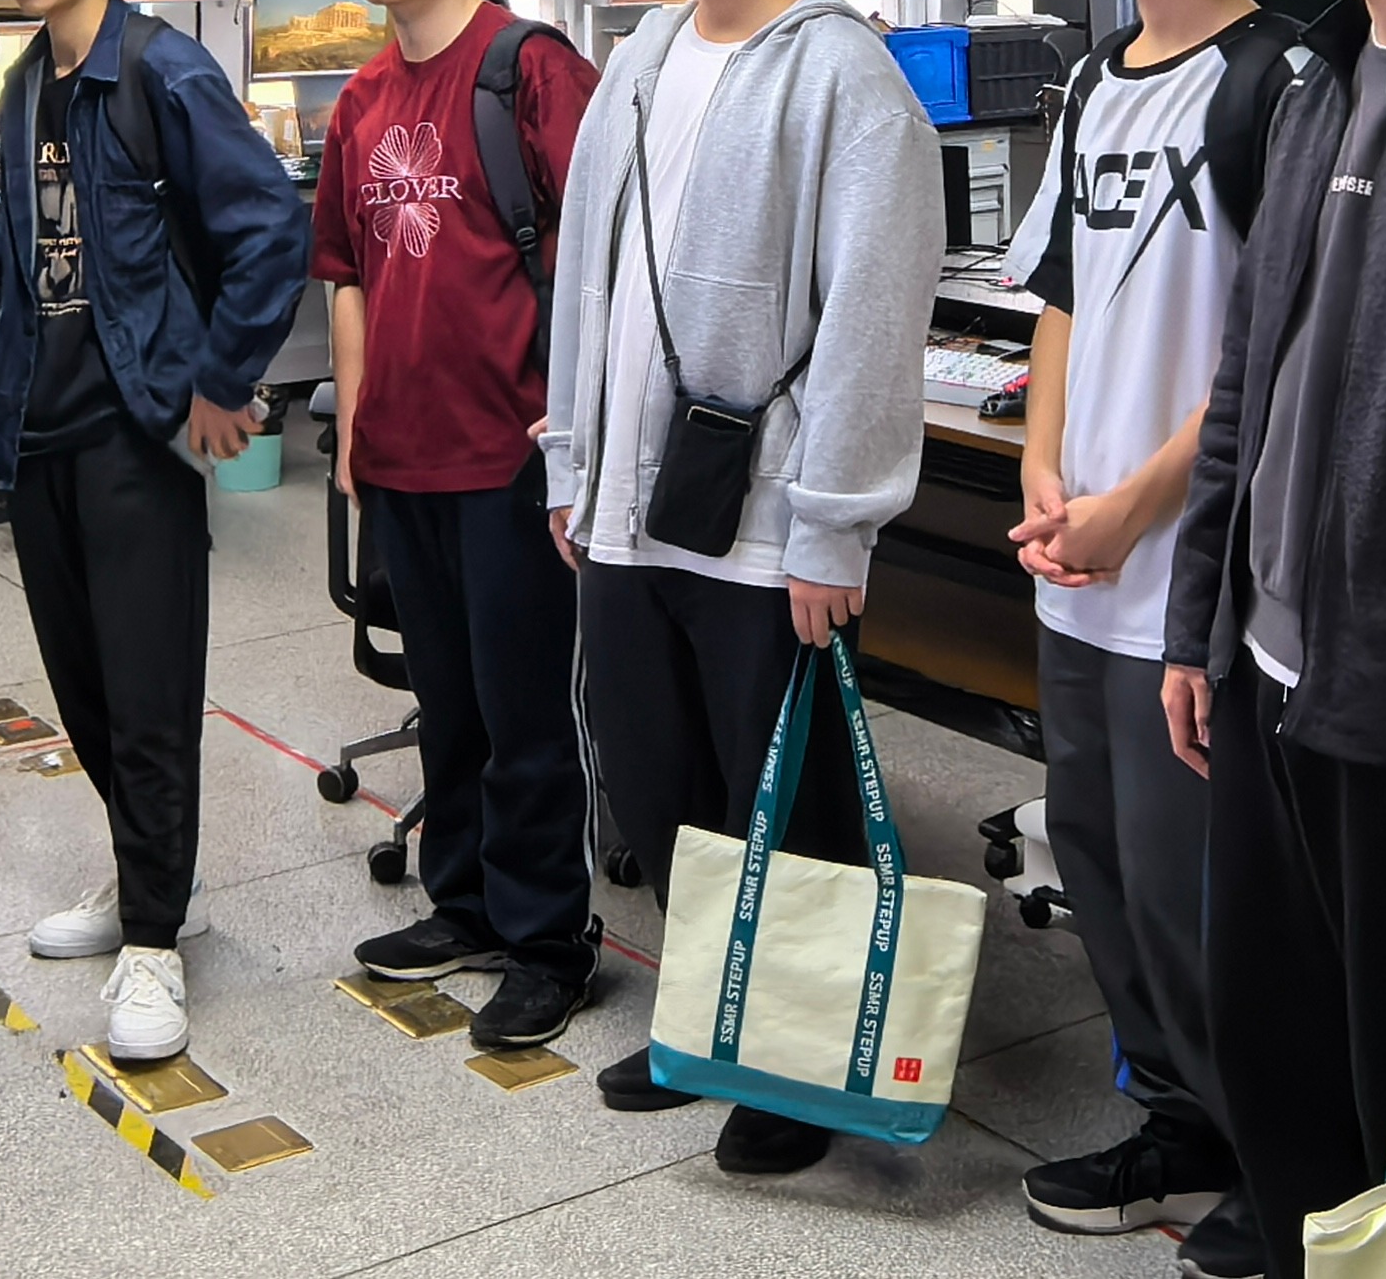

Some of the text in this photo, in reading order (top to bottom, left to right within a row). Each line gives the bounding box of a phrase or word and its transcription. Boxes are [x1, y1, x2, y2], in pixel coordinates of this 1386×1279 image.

[361, 175, 463, 205] CLOVER
[1074, 145, 1210, 313] ACEX
[863, 759, 884, 822] STEPUP
[740, 810, 767, 921] SSMR STEPUP
[875, 843, 895, 951] SSMR STEPUP
[720, 940, 746, 1045] SSMR STEPUP
[857, 971, 883, 1077] SSMR STEPUP
